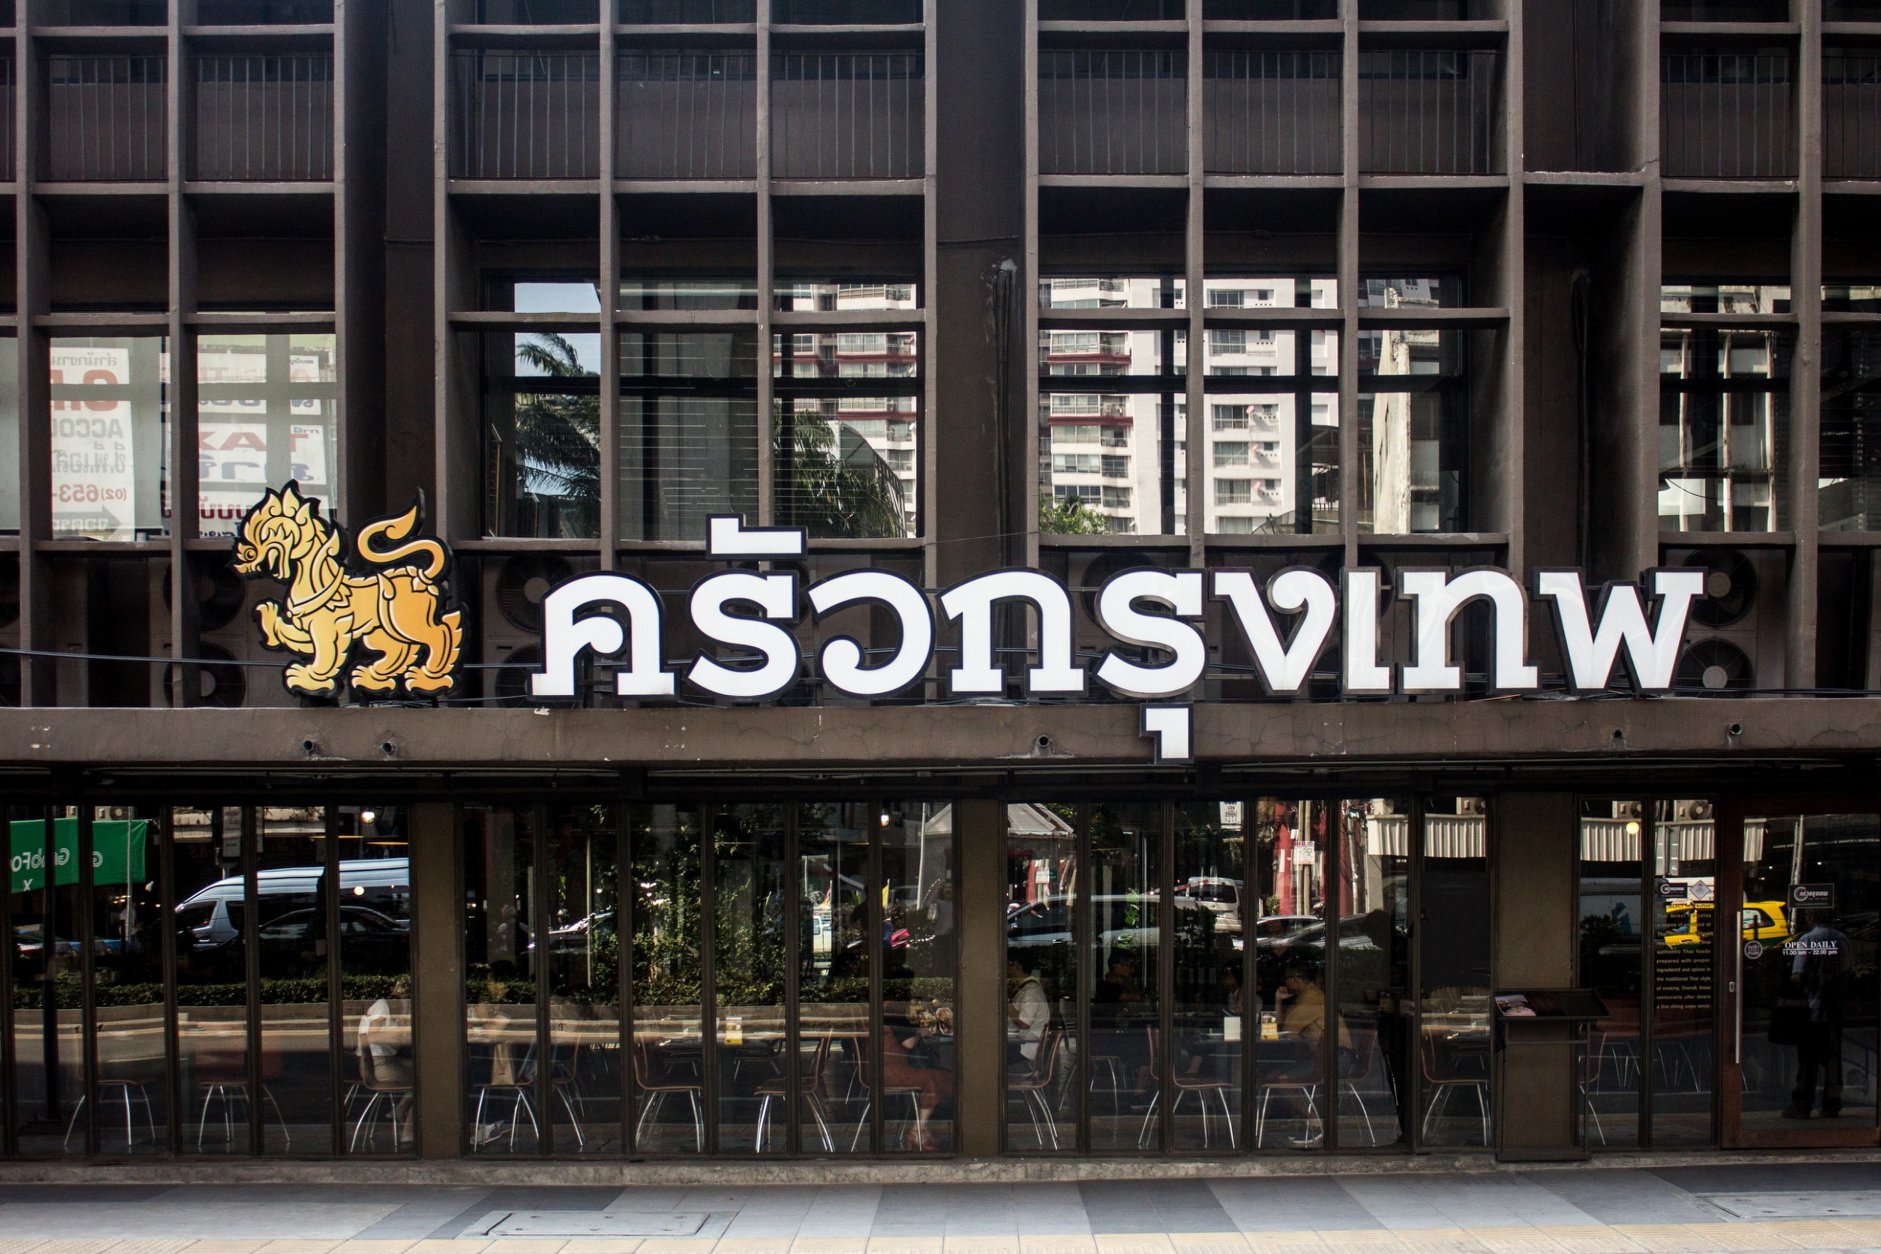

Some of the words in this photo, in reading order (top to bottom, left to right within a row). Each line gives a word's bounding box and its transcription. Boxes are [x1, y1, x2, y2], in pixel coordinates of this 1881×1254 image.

[532, 518, 1703, 759] ครัวกรุงเทพ
[1784, 941, 1808, 949] OPEN
[1810, 940, 1837, 948] DAILY
